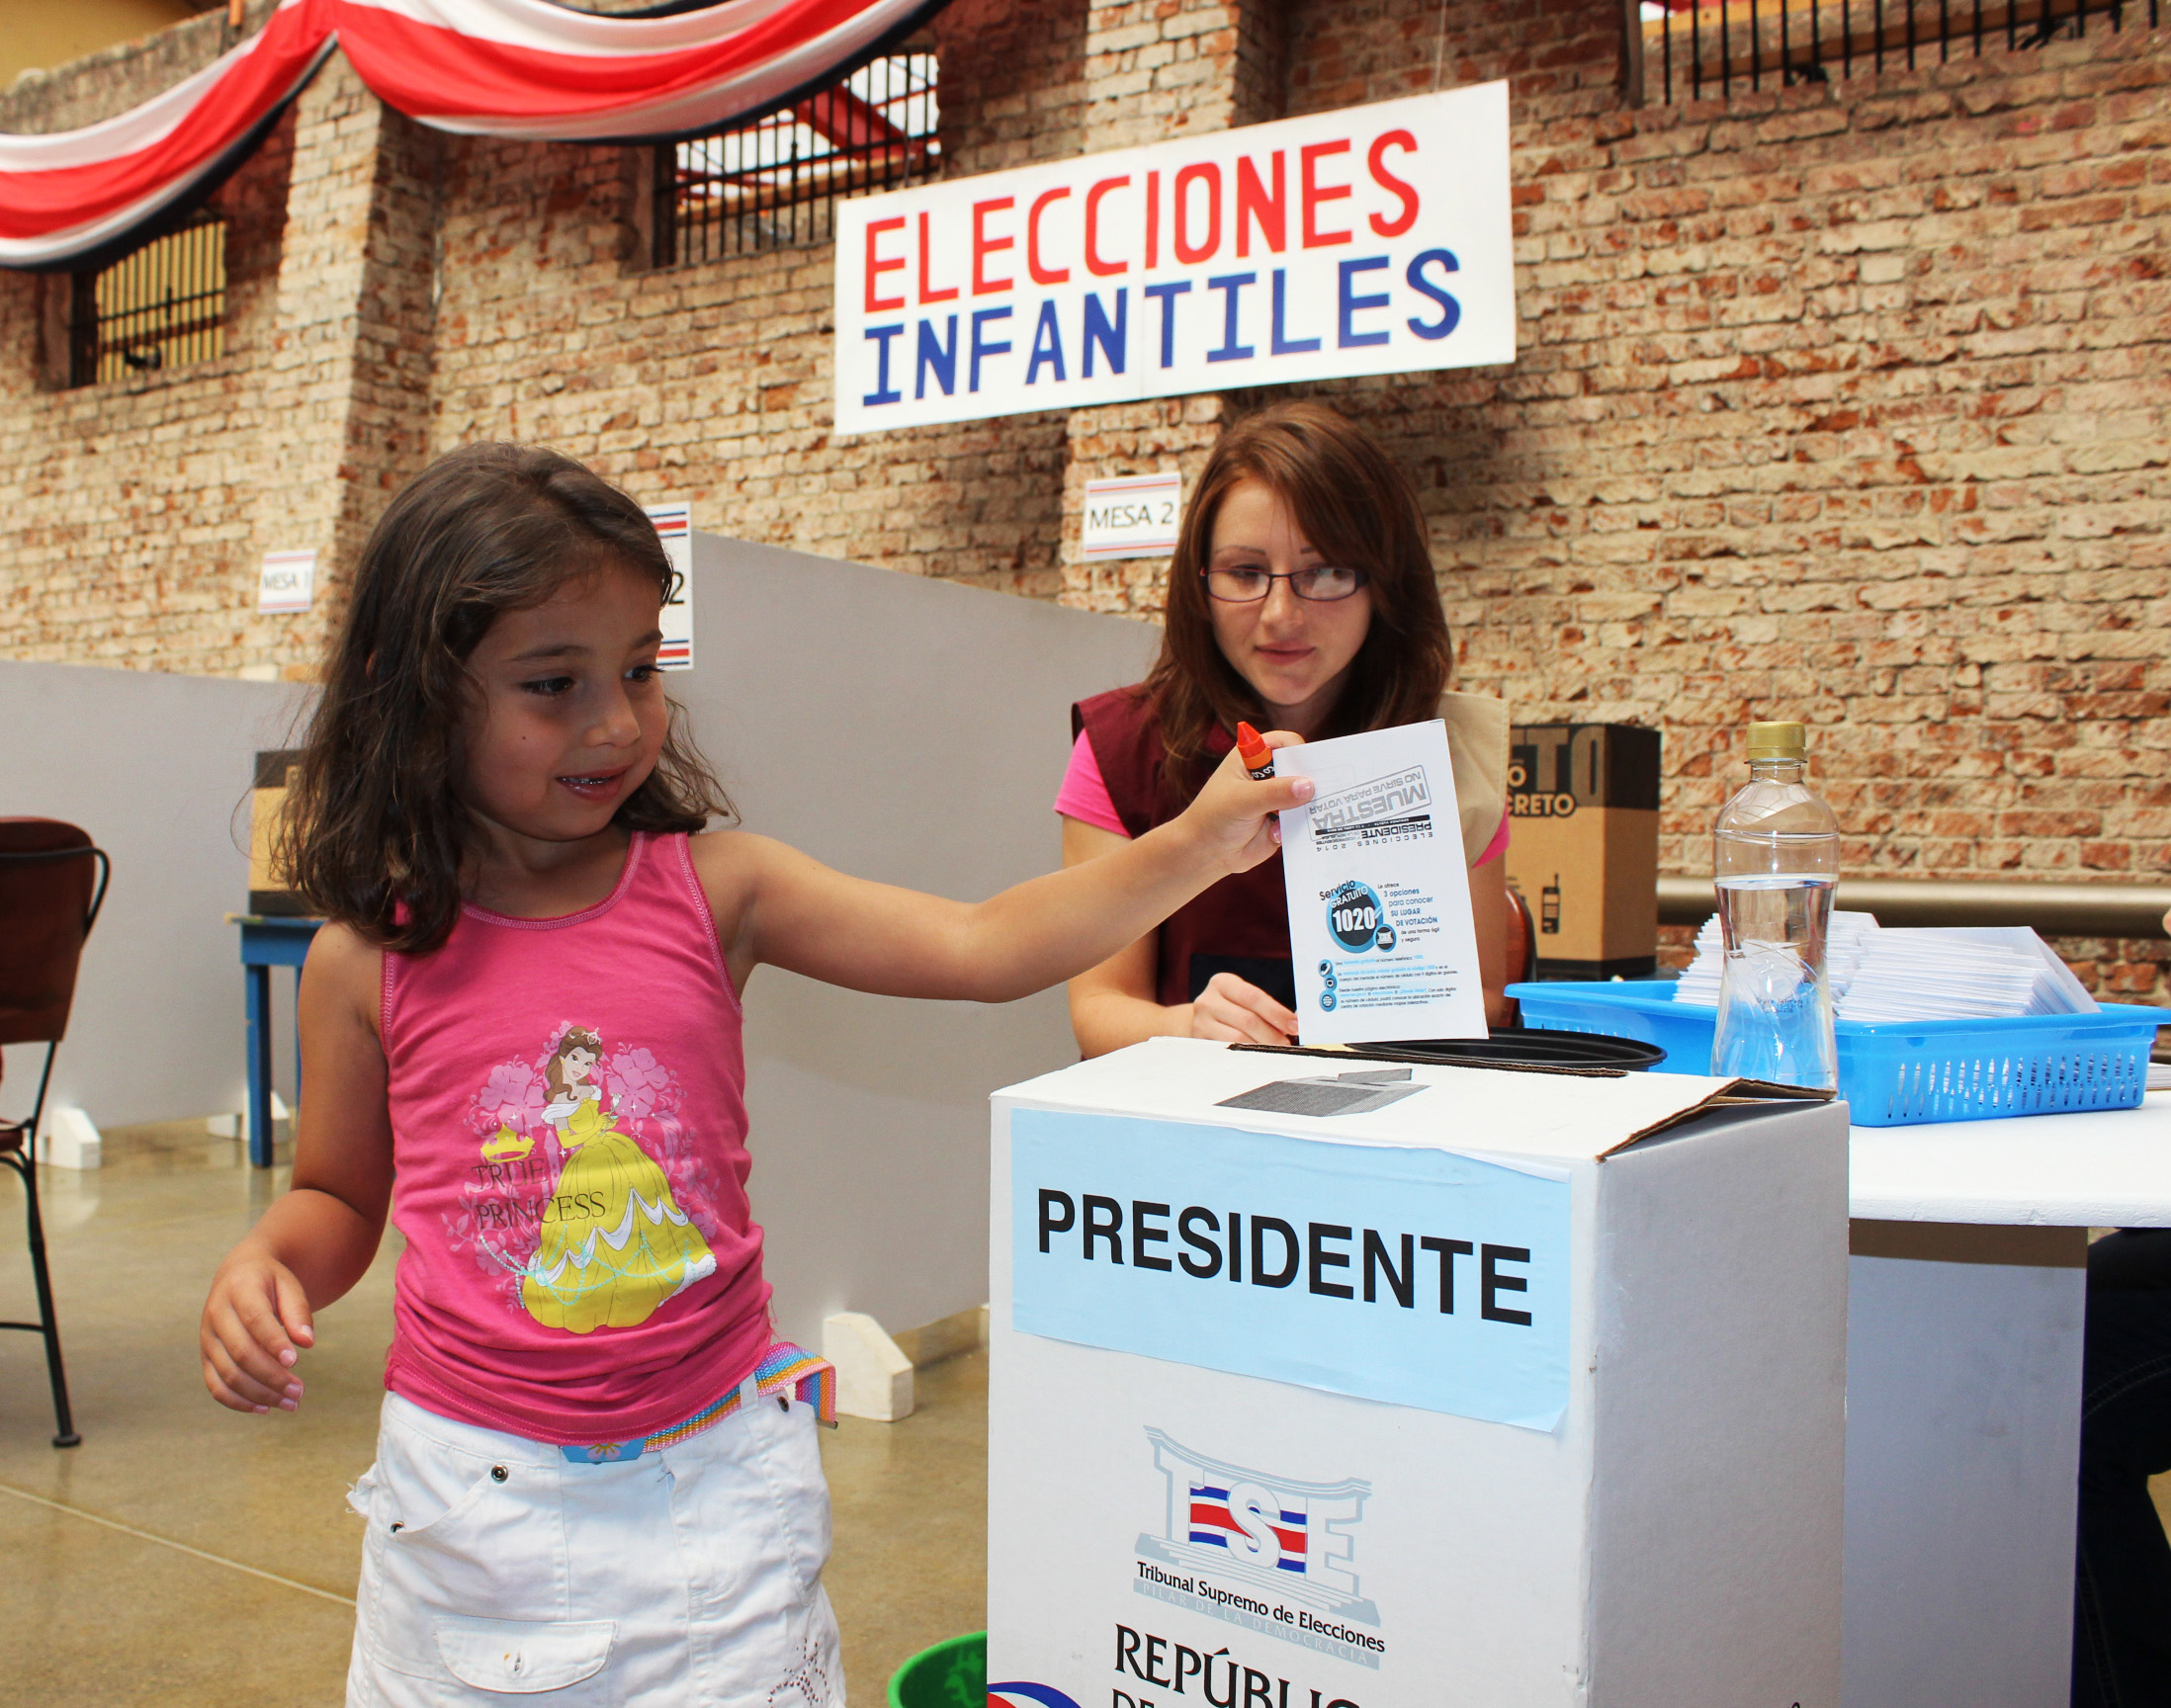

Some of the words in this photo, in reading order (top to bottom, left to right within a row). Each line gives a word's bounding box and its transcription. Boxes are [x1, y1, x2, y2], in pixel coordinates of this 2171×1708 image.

[864, 128, 1420, 313] ELECCIONES
[863, 247, 1461, 407] INFANTILES
[1090, 504, 1152, 530] MESA
[1161, 501, 1174, 524] 2
[668, 570, 685, 605] 2
[1373, 778, 1404, 794] SIRVE
[1404, 772, 1422, 783] NO
[1309, 799, 1343, 814] VOTAR
[1312, 783, 1427, 829] MUESTRA
[1345, 787, 1372, 803] PARA
[1357, 832, 1433, 847] ELECCIONES
[1361, 821, 1432, 839] PRESIDENTE
[1316, 843, 1346, 852] 2014
[1319, 880, 1355, 900] Servicio
[1330, 886, 1369, 908] GRATUITO
[1389, 889, 1420, 897] opciones
[1333, 906, 1375, 932] 1020
[1400, 907, 1421, 916] LUGAR
[1405, 915, 1437, 925] VOTACIÓN
[471, 1157, 547, 1190] TRUE
[476, 1191, 606, 1230] PRINCESS
[1038, 1188, 1532, 1326] PRESIDENTE
[1137, 1561, 1194, 1593] Tribunal
[1198, 1580, 1269, 1616] Supremo
[1272, 1605, 1294, 1624] de
[1299, 1611, 1385, 1653] Elecciones
[1143, 1582, 1187, 1606] PILAR
[1195, 1600, 1214, 1615] DE
[1224, 1608, 1242, 1625] LA
[1253, 1616, 1368, 1665] DEMOCRACIA
[1114, 1623, 1361, 1708] REPÚBL
